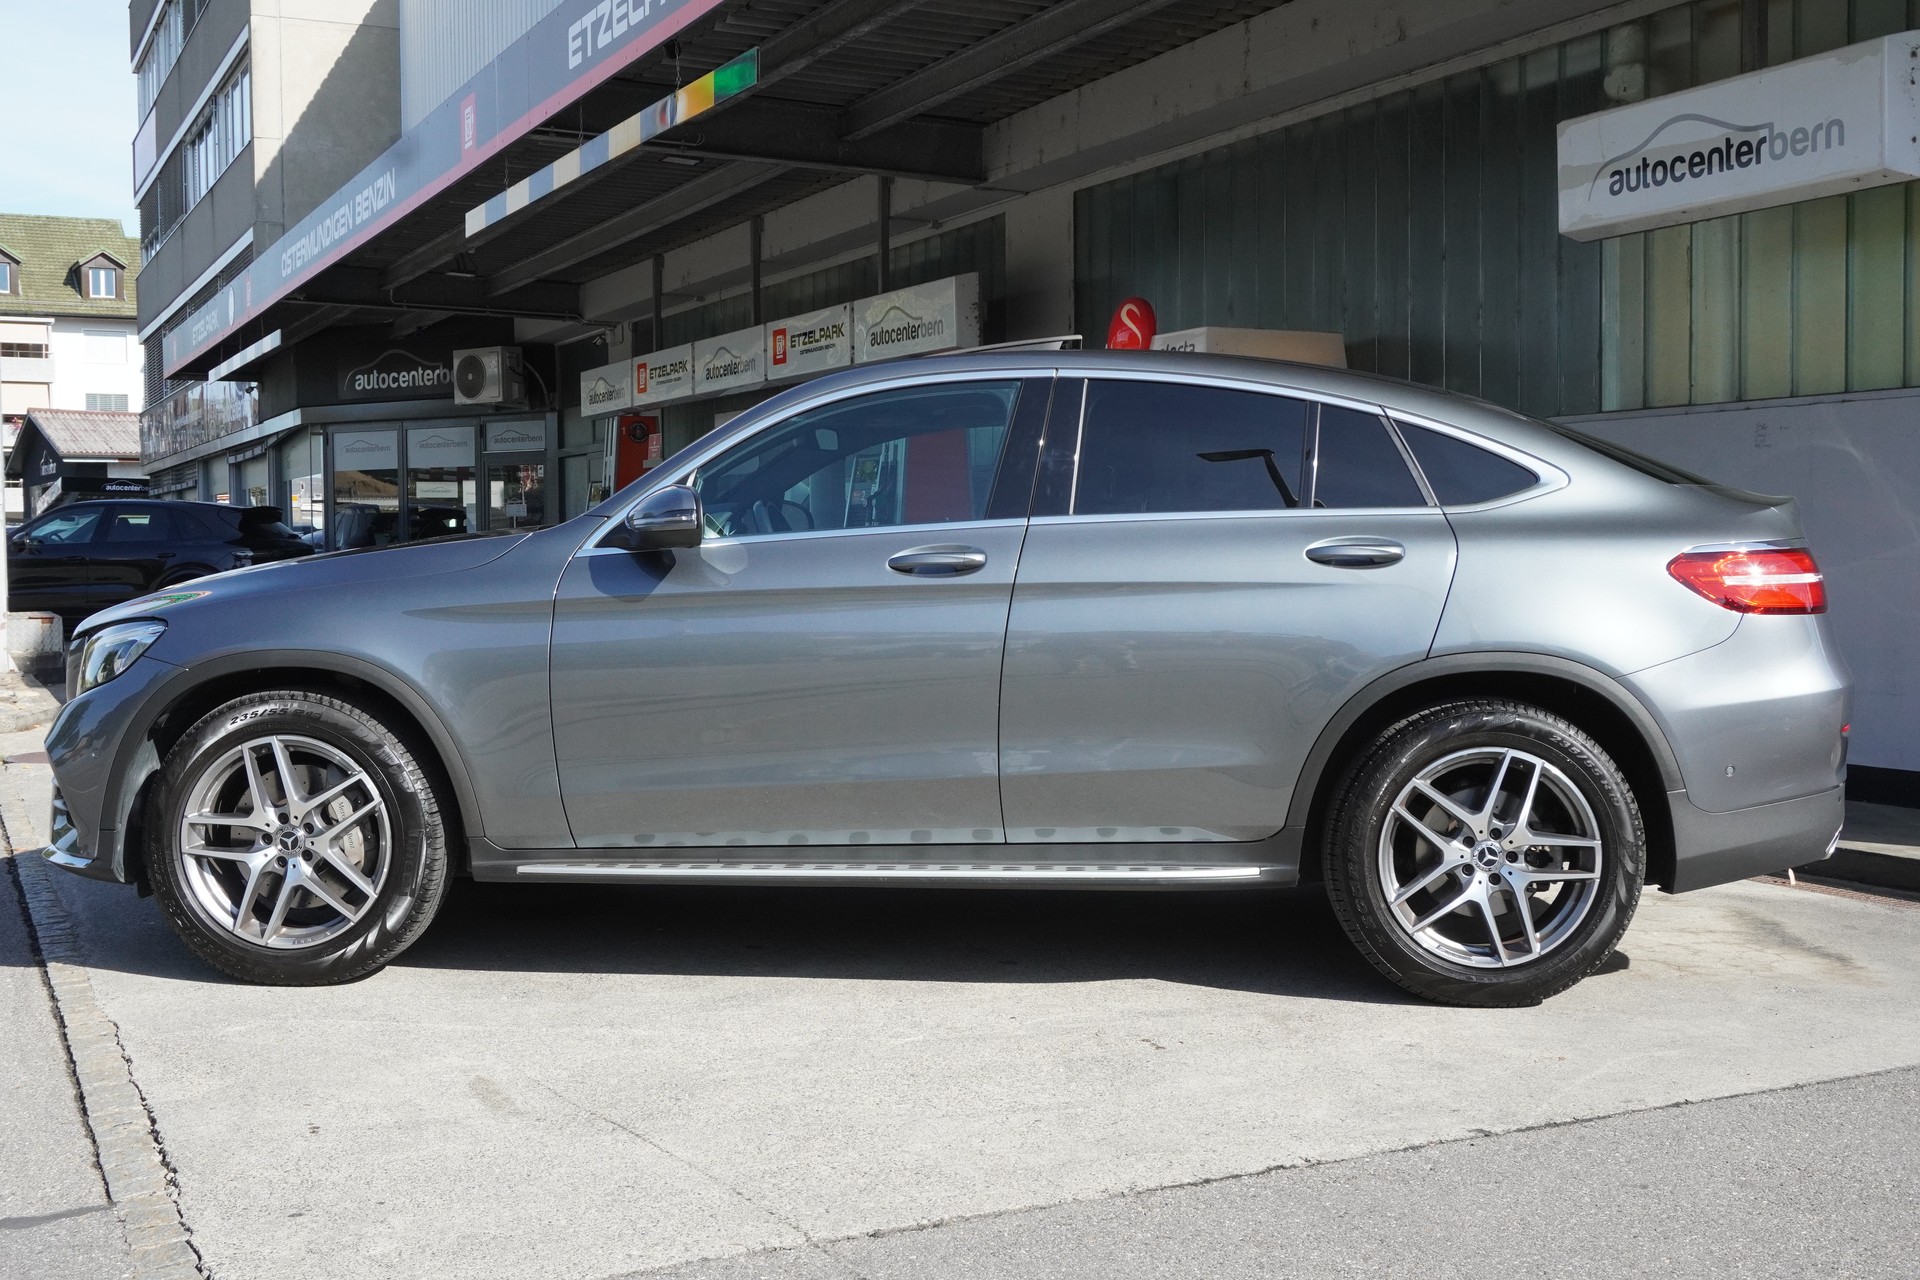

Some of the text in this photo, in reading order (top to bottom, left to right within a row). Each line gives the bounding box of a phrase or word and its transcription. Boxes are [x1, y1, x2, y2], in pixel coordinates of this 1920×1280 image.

[568, 0, 666, 70] ETZEL
[1608, 118, 1845, 197] autocenterbern
[281, 167, 395, 278] OSTERMUNDIGEN BENZIN
[790, 322, 845, 349] ETZELPARK
[870, 317, 944, 348] autocenterbern
[355, 363, 454, 391] autocenterb
[649, 360, 688, 380] ETZELPARK
[705, 357, 756, 381] autocenterbern
[493, 434, 543, 445] autocenterbern
[230, 708, 289, 726] 235/55
[1549, 734, 1621, 806] 235/55 R19
